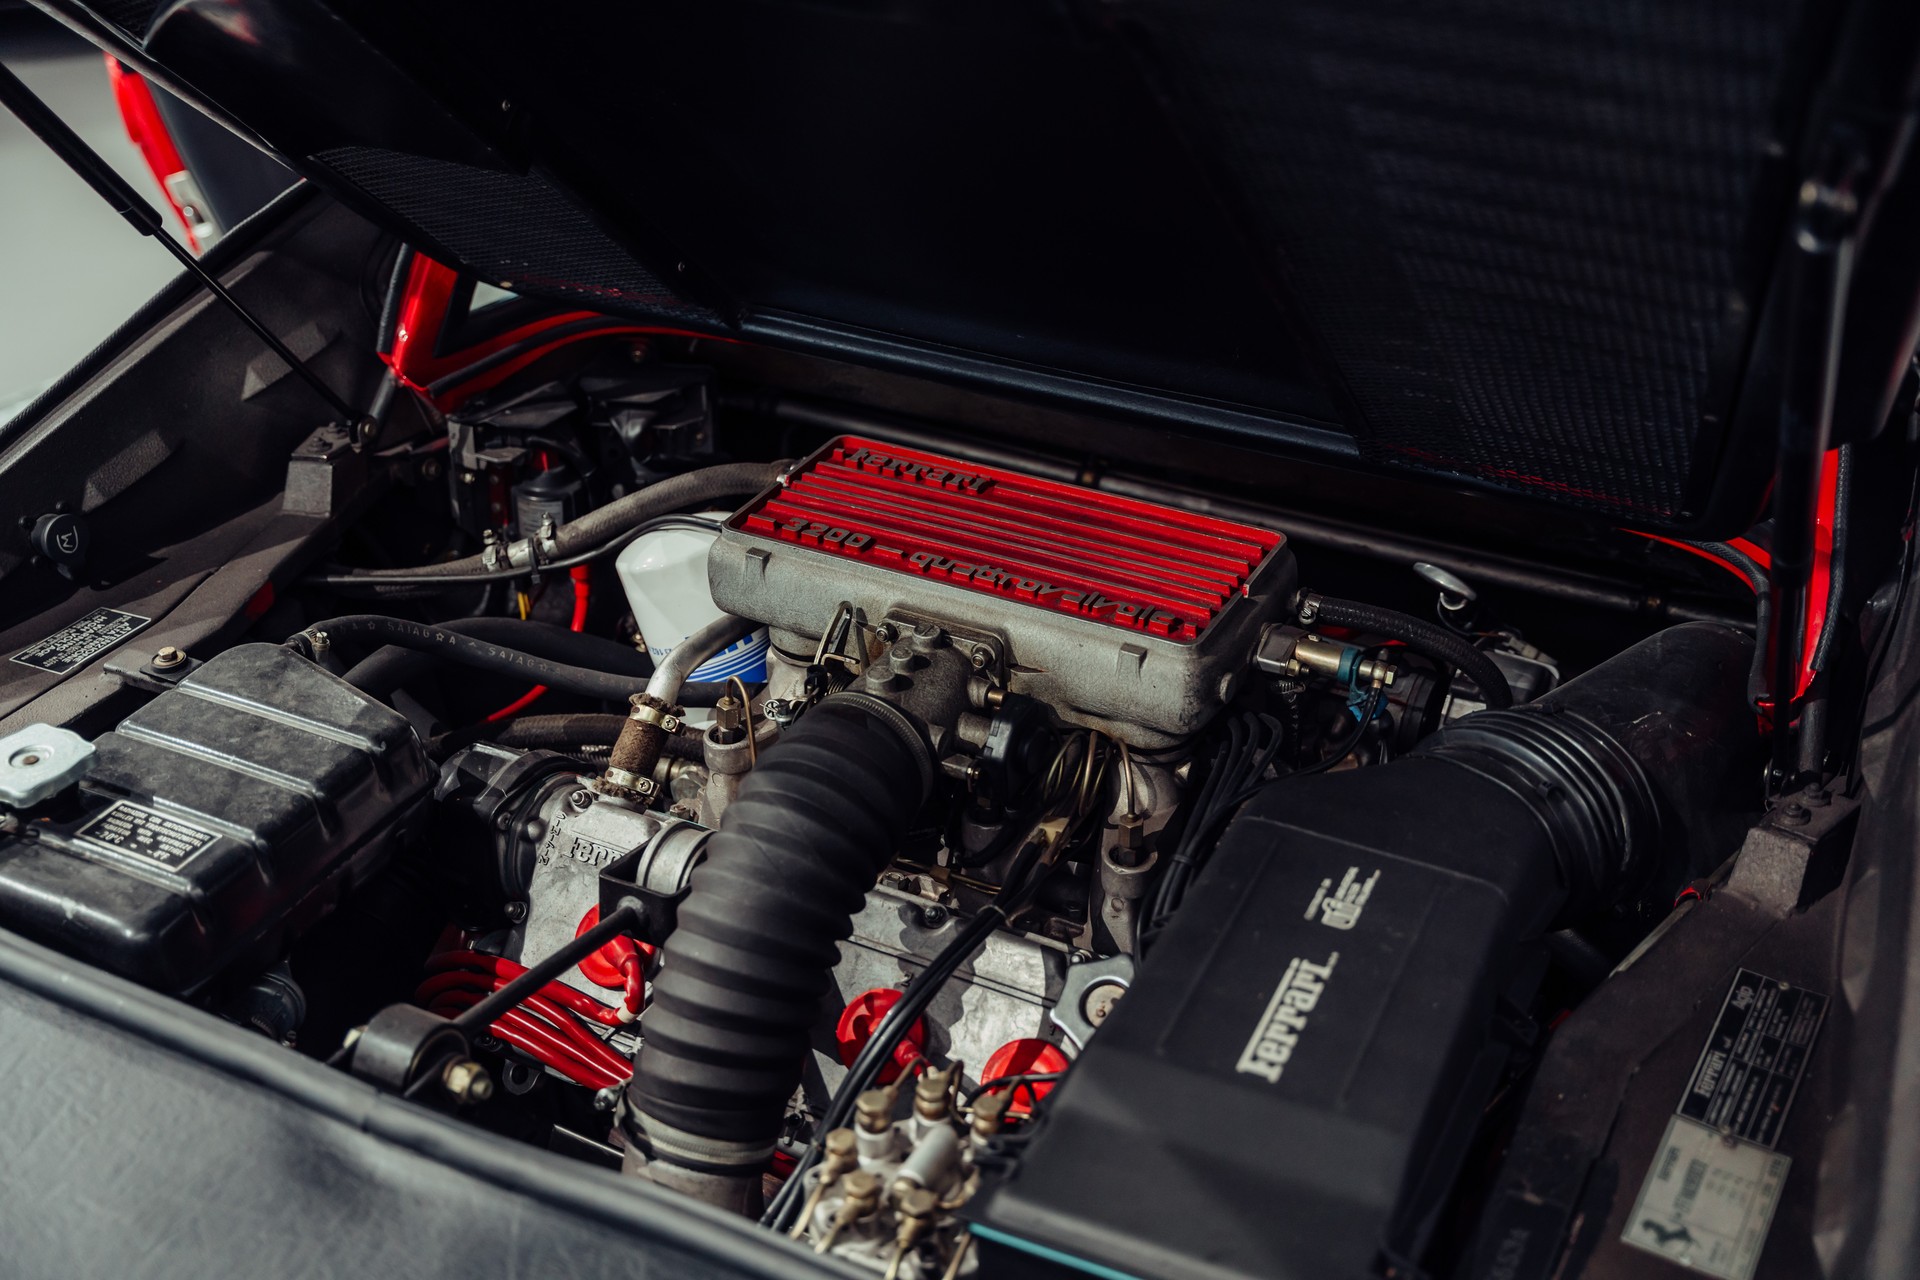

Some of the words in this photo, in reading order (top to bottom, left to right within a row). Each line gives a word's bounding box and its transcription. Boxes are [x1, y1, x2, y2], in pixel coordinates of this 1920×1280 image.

[845, 447, 993, 492] Ferrari
[782, 517, 872, 550] 3200
[909, 551, 1176, 624] quattrovalvole
[80, 615, 108, 631] HIGH
[107, 622, 130, 635] ALTA
[35, 633, 80, 657] VOLTAGE
[56, 624, 105, 651] WARNING
[61, 635, 110, 663] TENSIONE
[72, 626, 132, 662] ATTENZIONE
[487, 647, 535, 668] SAIAG
[1235, 951, 1340, 1084] Ferrari
[1693, 1050, 1727, 1098] Ferrari
[1731, 985, 1755, 1010] Agip
